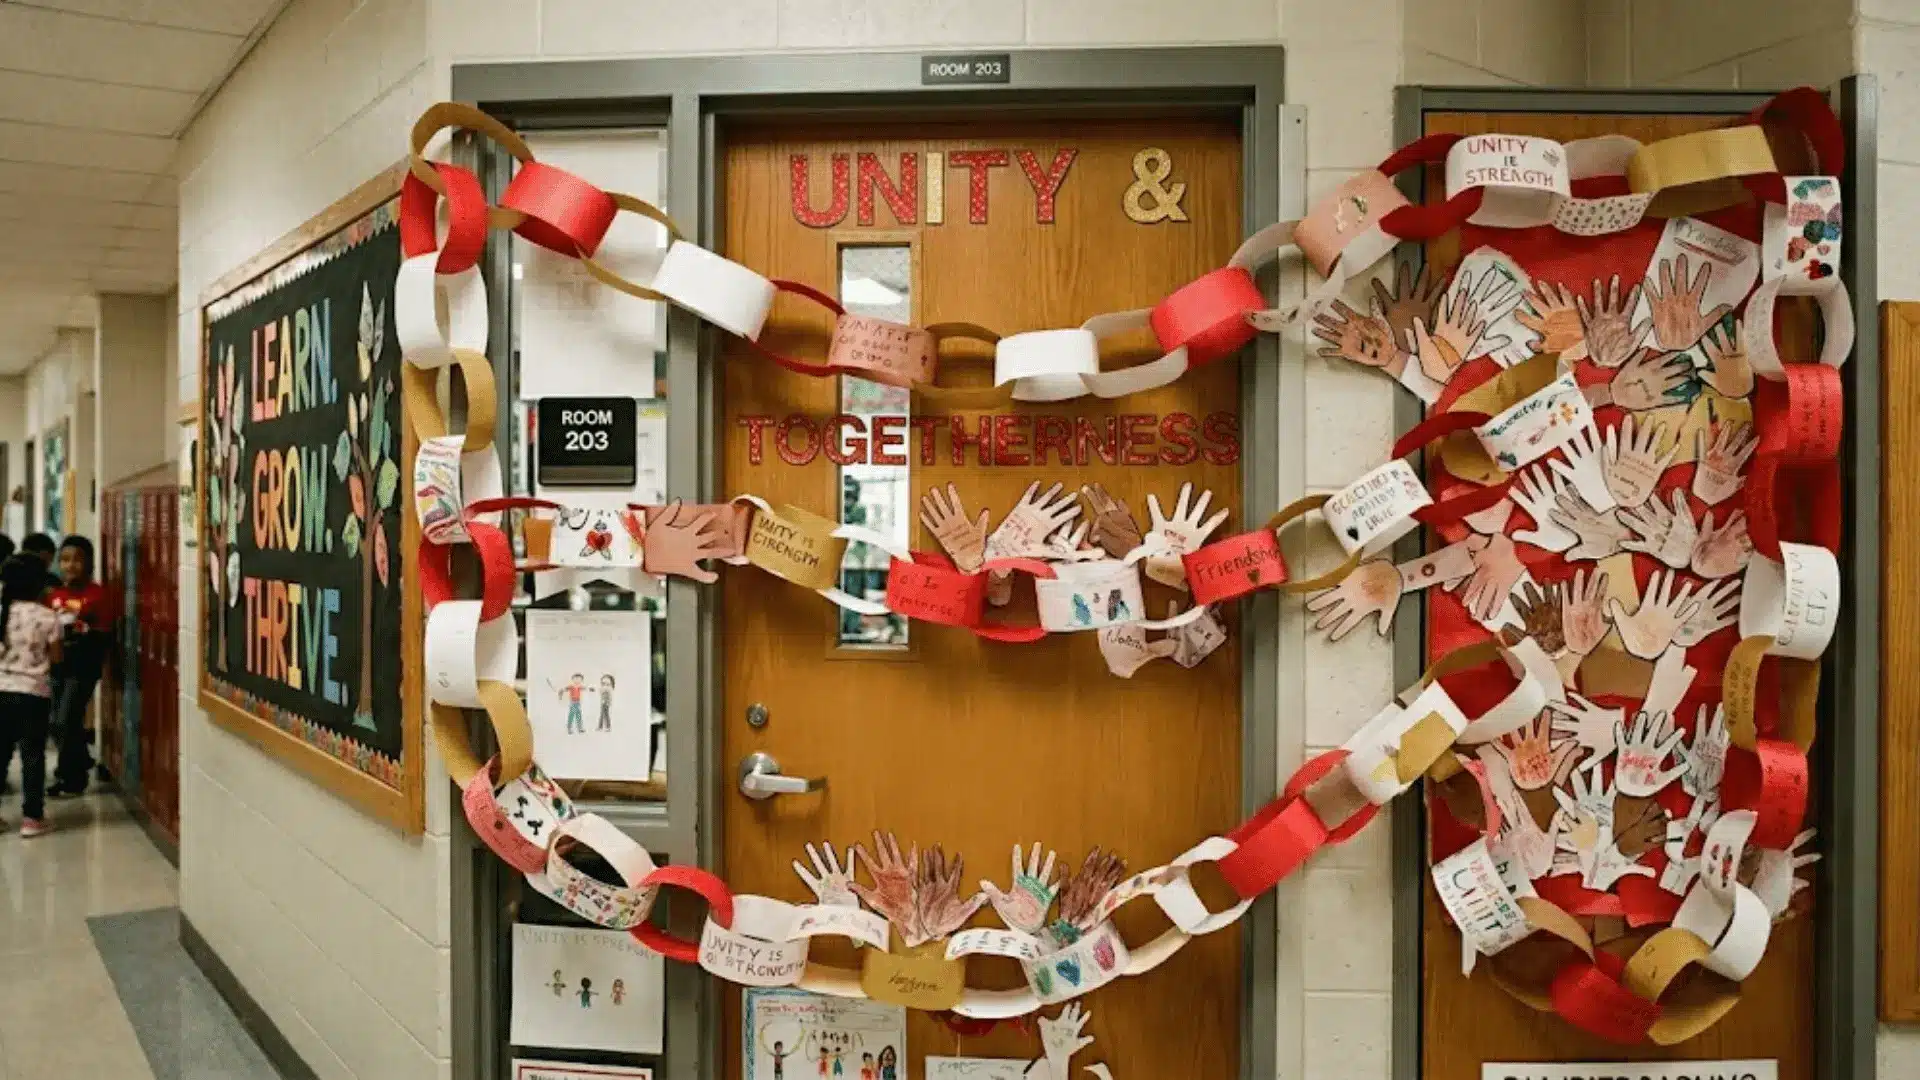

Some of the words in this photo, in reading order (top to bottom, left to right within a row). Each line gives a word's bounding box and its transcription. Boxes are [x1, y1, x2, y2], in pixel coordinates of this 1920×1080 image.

[930, 63, 970, 76] ROOM
[975, 62, 1001, 76] 203
[1467, 137, 1528, 154] UNITY
[789, 147, 1078, 228] UNITY
[1122, 147, 1190, 224] &
[251, 298, 337, 422] LEARN.
[561, 409, 613, 425] ROOM
[564, 430, 609, 451] 203
[738, 412, 1241, 466] TOGETHERNESS
[252, 443, 333, 554] GROW.
[244, 577, 348, 707] THRIVE.
